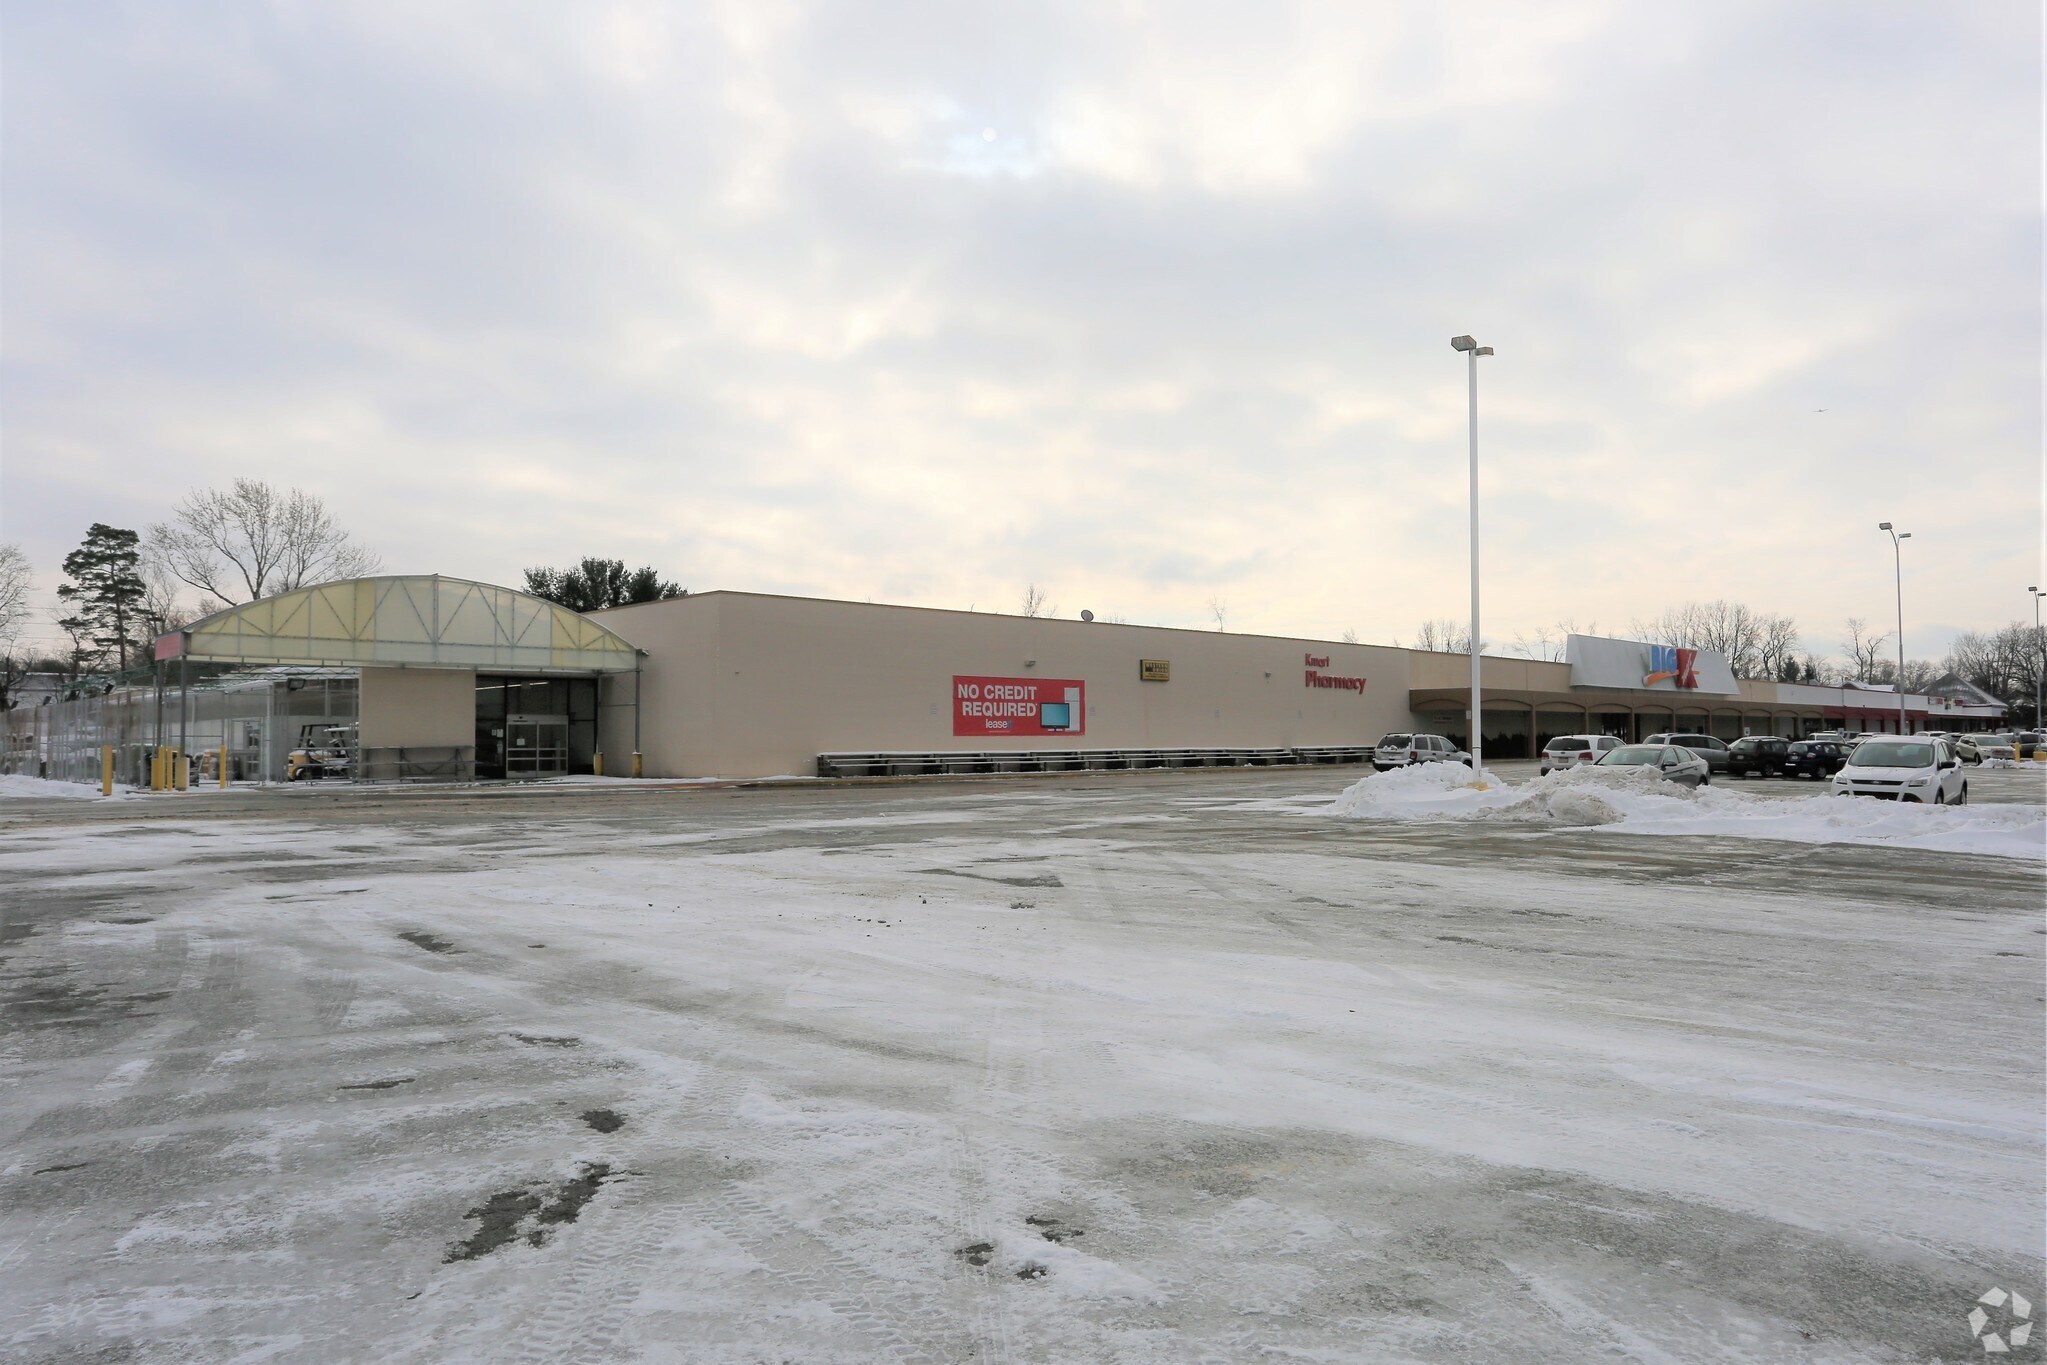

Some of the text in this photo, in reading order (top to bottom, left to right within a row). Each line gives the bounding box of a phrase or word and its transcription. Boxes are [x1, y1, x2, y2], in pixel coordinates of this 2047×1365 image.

[1305, 653, 1329, 667] Kmart
[1676, 648, 1698, 688] K
[1305, 670, 1366, 695] Pharmacy
[958, 684, 1037, 700] NO CREDIT
[962, 702, 1036, 717] REQUIRED
